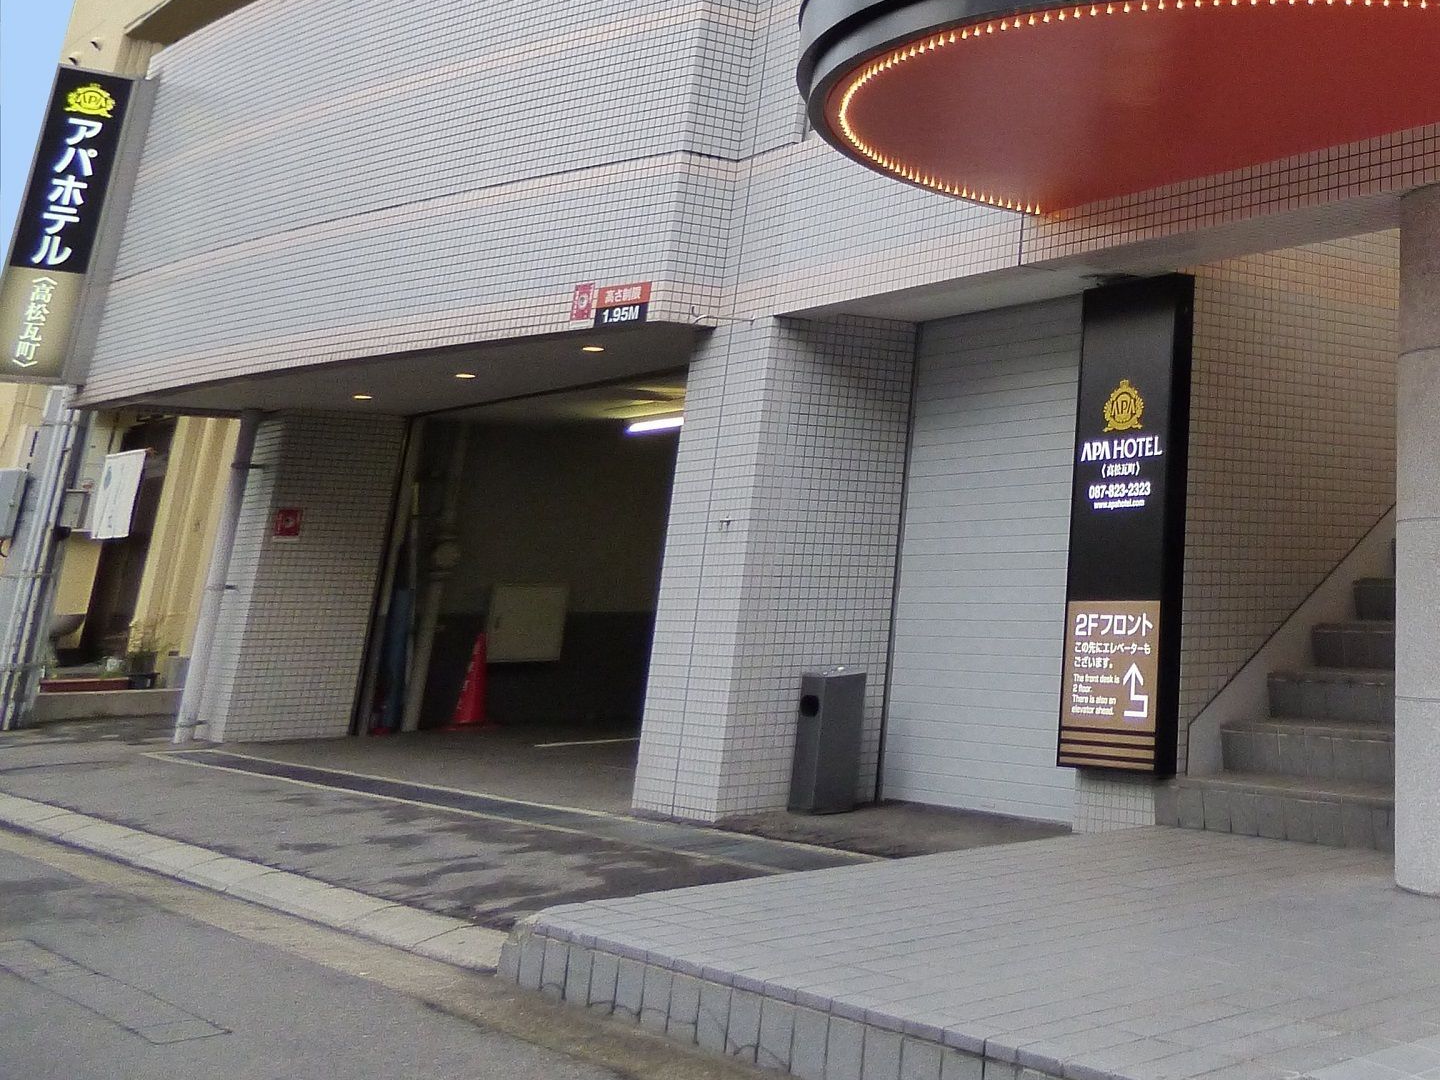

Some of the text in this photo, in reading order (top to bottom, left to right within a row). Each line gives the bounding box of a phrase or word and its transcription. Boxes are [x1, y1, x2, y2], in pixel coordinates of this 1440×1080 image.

[31, 117, 103, 266] アパホテル
[604, 286, 641, 304] 高さ制限
[602, 305, 640, 324] 1.95M
[1081, 436, 1163, 461] APA HOTEL
[1088, 482, 1151, 499] 087-823-2323
[1093, 499, 1145, 510] www.apahotel.com
[1074, 641, 1151, 655] この先にエレベーターも
[1073, 656, 1113, 669] ございます。
[1073, 673, 1084, 682] The
[1085, 674, 1099, 683] front
[1114, 675, 1120, 684] is
[1072, 683, 1078, 693] 2
[1072, 694, 1088, 703] There
[1089, 695, 1095, 704] is
